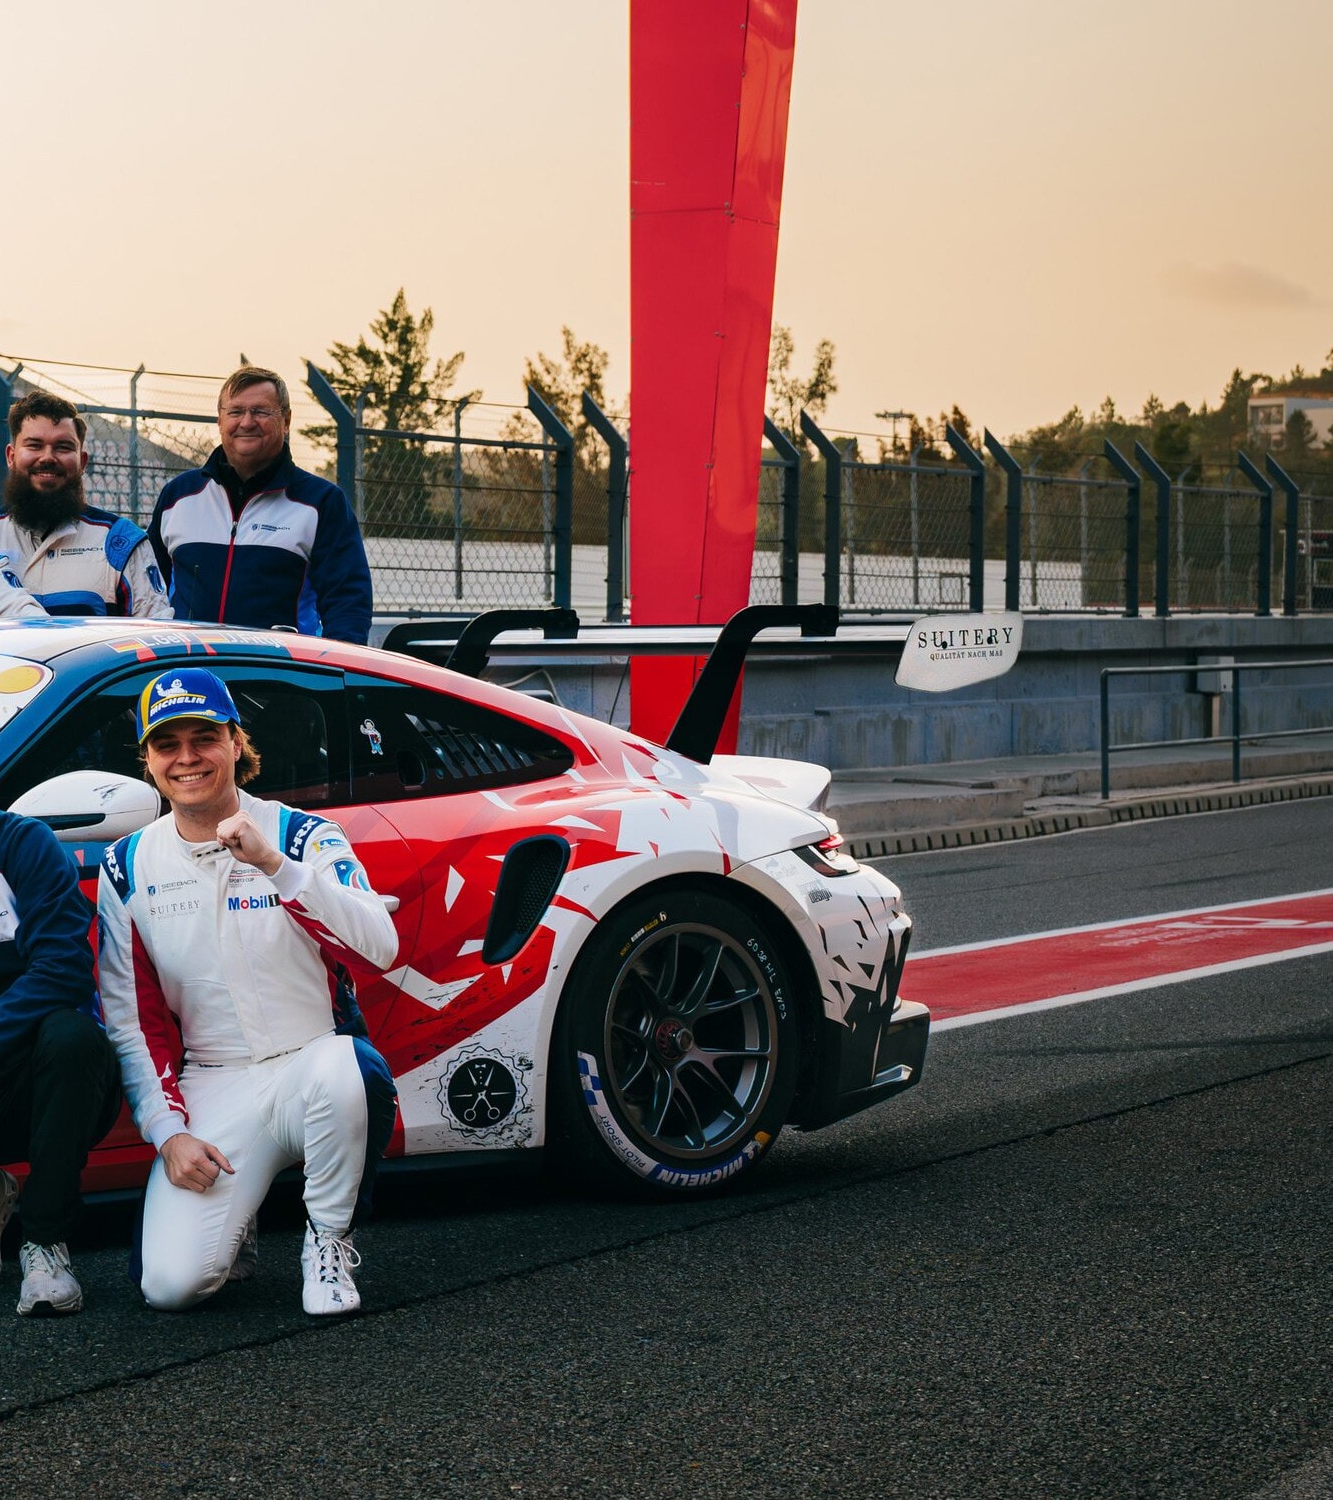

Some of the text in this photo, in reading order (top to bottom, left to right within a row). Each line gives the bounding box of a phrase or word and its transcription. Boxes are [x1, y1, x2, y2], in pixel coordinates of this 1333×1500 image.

[918, 627, 1013, 649] SUITERY
[930, 651, 965, 661] QUALITÄT
[967, 650, 987, 658] NACH
[150, 696, 206, 717] MICHELIN
[290, 818, 318, 856] HRX
[105, 845, 125, 882] HRX
[150, 900, 200, 916] SUITERY
[598, 1114, 647, 1169] PILOT SPORT
[656, 1155, 744, 1188] MICHELIN
